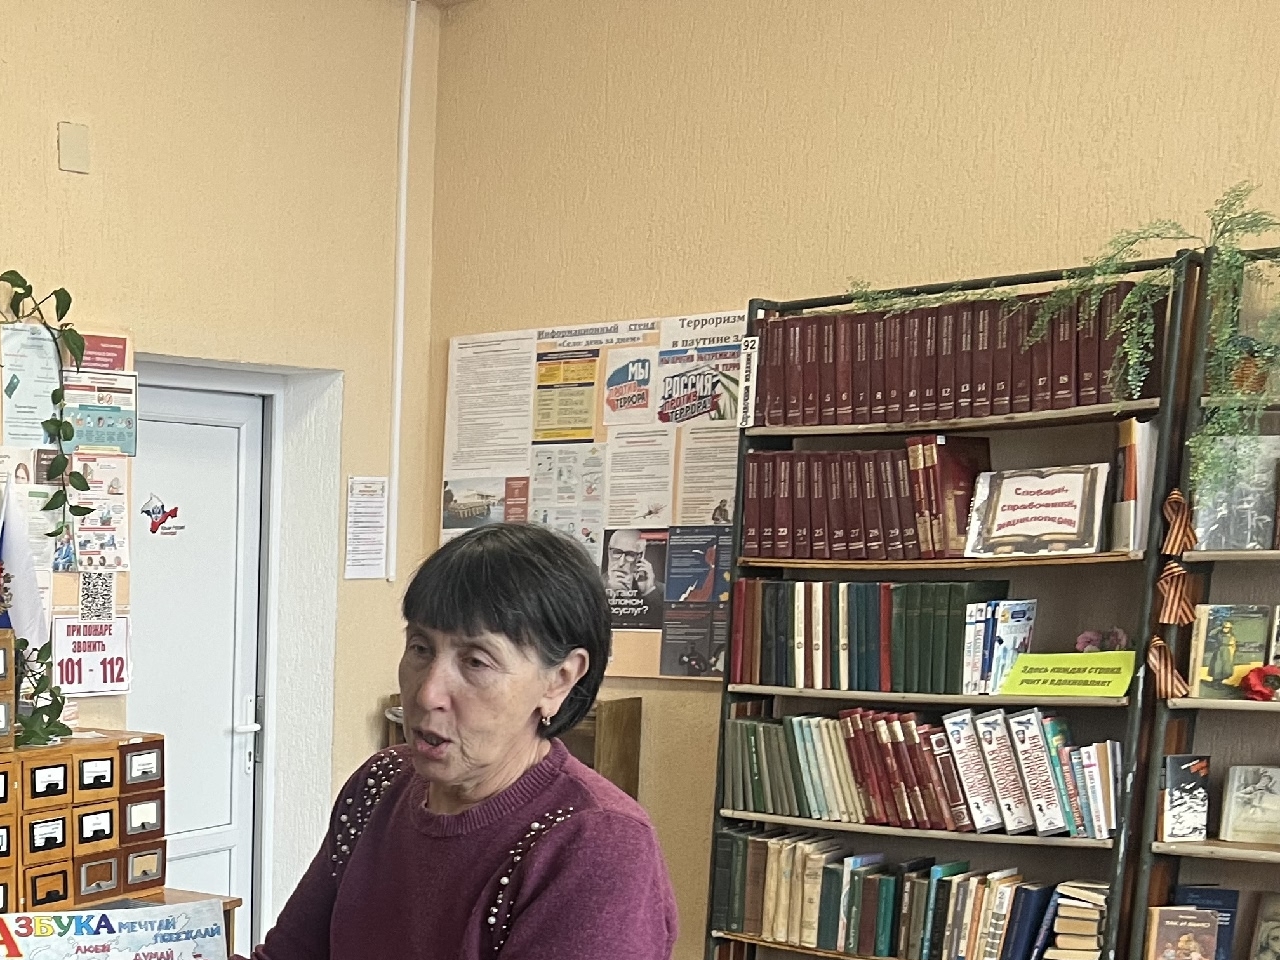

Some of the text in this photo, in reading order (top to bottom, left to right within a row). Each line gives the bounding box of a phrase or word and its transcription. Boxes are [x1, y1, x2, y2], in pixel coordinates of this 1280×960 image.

[678, 312, 746, 330] Терроризм
[537, 322, 619, 340] Информационный
[586, 338, 605, 347] день
[680, 335, 731, 348] паутине
[742, 340, 756, 350] 92
[627, 361, 650, 382] МЫ
[664, 372, 715, 399] РОССИЯ
[614, 391, 648, 409] ТЕРРОРА
[661, 390, 698, 410] ПРОТИВ
[763, 528, 772, 536] 22
[777, 527, 787, 536] 23
[850, 528, 860, 537] 27
[903, 528, 914, 536] 30
[605, 589, 638, 599] Пугают
[66, 624, 112, 636] ПРИ ПОЖАРЕ
[72, 640, 106, 653] ЗВОНИТЬ
[57, 657, 82, 685] 101
[100, 656, 125, 684] 112
[956, 733, 995, 806] ШКОЛЬНАЯ ЭНЦИКЛОПЕДИЯ
[987, 734, 1026, 809] ШКОЛЬНАЯ ЭНЦИКЛОПЕДИЯ
[1021, 734, 1058, 810] ШКОЛЬНАЯ ЭНЦИКЛОПЕДИЯ
[118, 915, 176, 934] МЕЧТАЙ
[75, 942, 111, 955] ЛЮБИ
